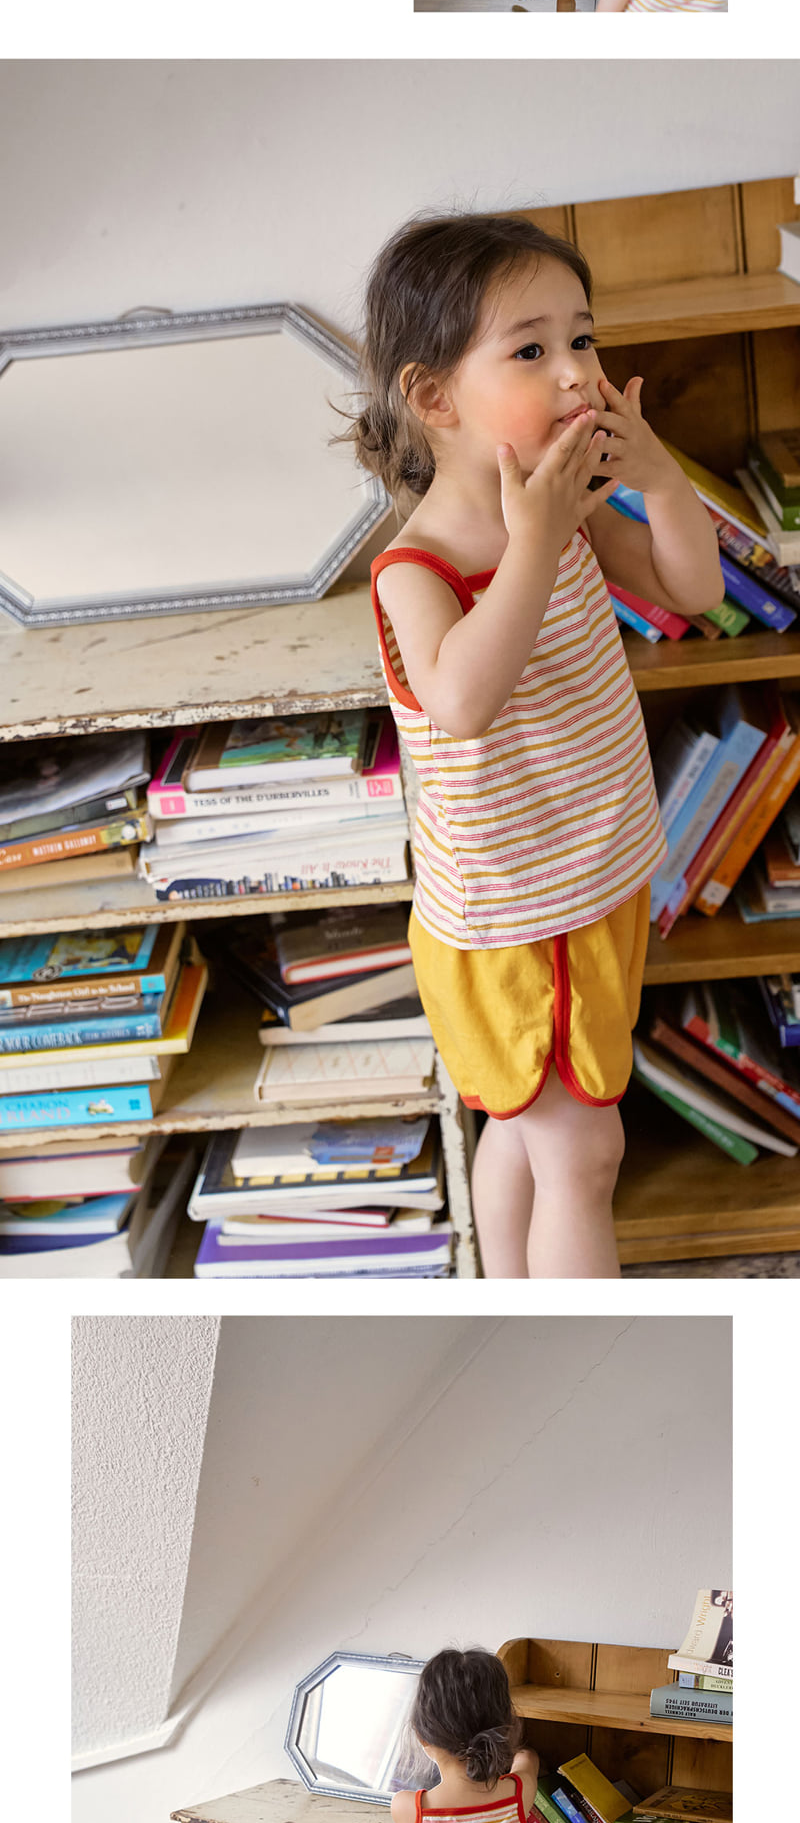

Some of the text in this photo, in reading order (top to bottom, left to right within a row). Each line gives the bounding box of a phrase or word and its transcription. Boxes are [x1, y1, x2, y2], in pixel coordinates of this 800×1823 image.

[194, 788, 330, 807] TESS OF THE D'URBERVILLES
[32, 842, 63, 857] MATTHEW
[72, 987, 90, 997] Girl
[108, 982, 136, 993] School
[31, 1031, 83, 1048] COMEBACK
[4, 1099, 71, 1111] CHABON
[664, 1704, 718, 1715] DEUTSCHSPRACHIGEN
[691, 1701, 718, 1709] LITERATUR
